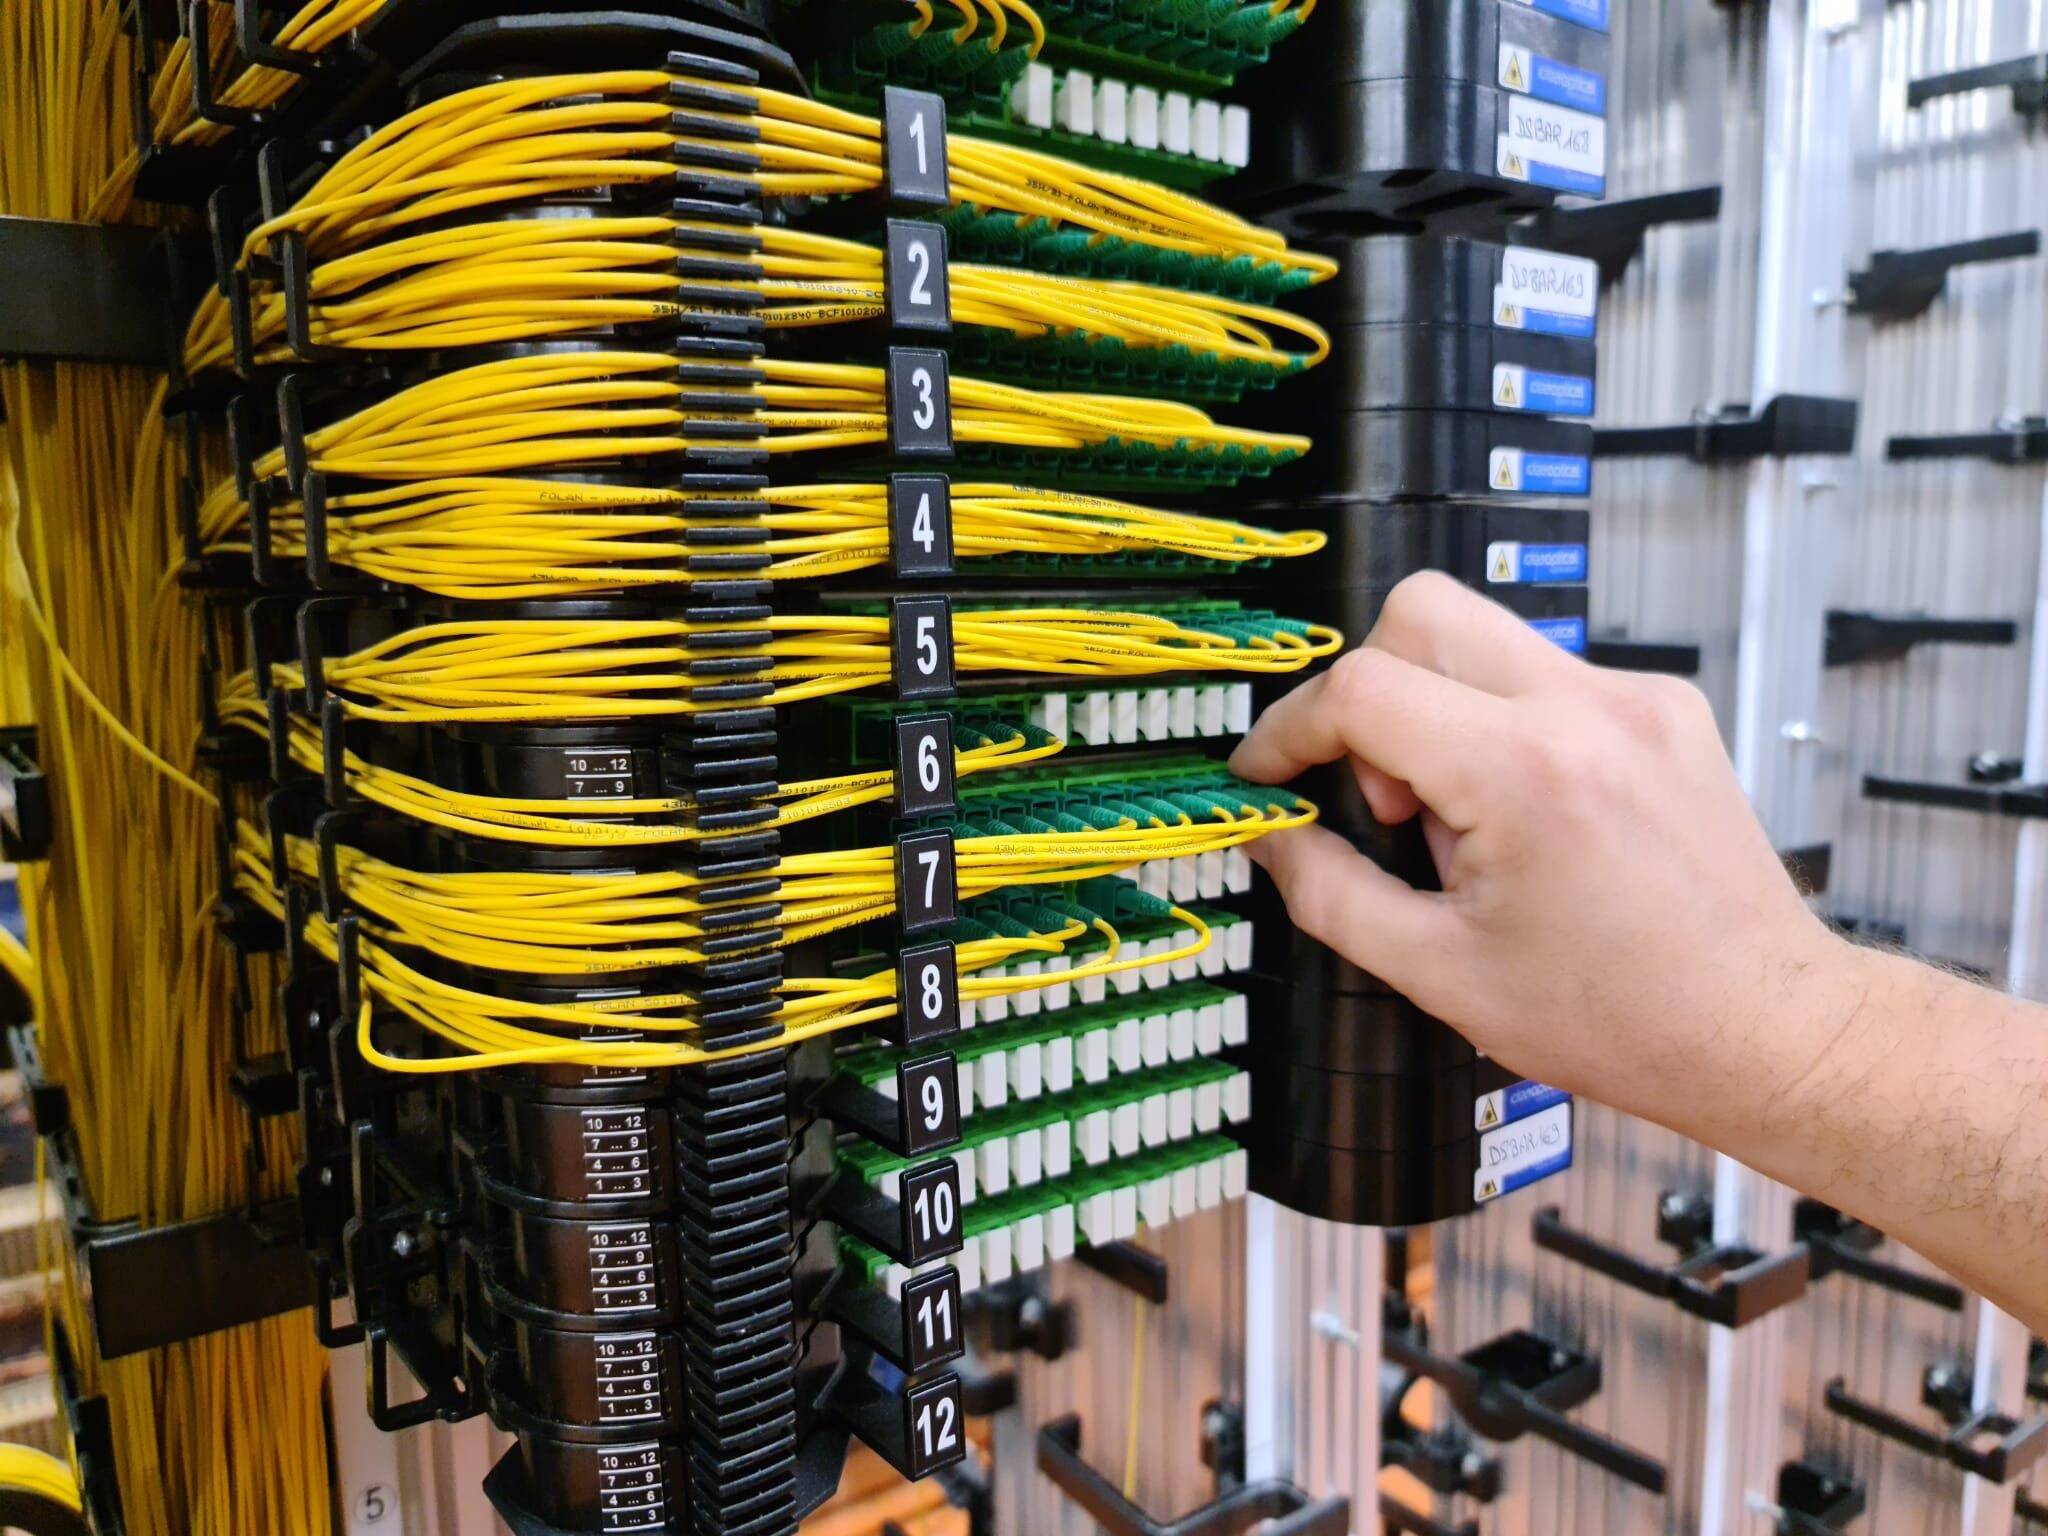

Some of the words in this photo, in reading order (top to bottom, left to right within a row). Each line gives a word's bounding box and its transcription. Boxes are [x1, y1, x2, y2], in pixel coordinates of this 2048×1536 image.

[908, 111, 927, 175] 1
[907, 240, 932, 305] 2
[911, 367, 935, 430] 3
[912, 493, 935, 553] 4
[916, 616, 938, 675] 5
[569, 758, 587, 772] 10
[609, 758, 628, 771] 12
[918, 734, 940, 792] 6
[574, 781, 585, 793] 7
[615, 780, 625, 793] 9
[918, 850, 940, 908] 7
[921, 964, 943, 1019] 8
[921, 1075, 944, 1130] 9
[586, 1117, 603, 1131] 10
[625, 1115, 642, 1128] 12
[591, 1138, 601, 1150] 7
[630, 1136, 639, 1148] 9
[592, 1158, 603, 1171] 4
[631, 1156, 641, 1169] 6
[595, 1178, 603, 1191] 1
[633, 1176, 642, 1189] 3
[914, 1181, 954, 1241] 10
[592, 1233, 609, 1246] 10
[630, 1230, 647, 1243] 12
[597, 1253, 607, 1265] 7
[635, 1250, 645, 1263] 9
[599, 1273, 609, 1285] 4
[637, 1270, 646, 1282] 6
[601, 1293, 609, 1305] 1
[639, 1290, 648, 1303] 3
[918, 1289, 952, 1348] 11
[599, 1343, 615, 1356] 10
[636, 1340, 653, 1353] 12
[604, 1363, 613, 1375] 7
[641, 1360, 650, 1372] 9
[605, 1382, 614, 1395] 4
[642, 1379, 652, 1391] 6
[607, 1402, 615, 1414] 1
[644, 1398, 653, 1411] 3
[917, 1397, 956, 1456] 12
[602, 1456, 619, 1468] 10
[640, 1451, 656, 1465] 12
[607, 1475, 616, 1487] 7
[645, 1471, 654, 1483] 9
[366, 1486, 385, 1520] 5
[609, 1494, 618, 1506] 4
[646, 1490, 655, 1502] 6
[611, 1513, 618, 1525] 1
[648, 1509, 657, 1521] 3
